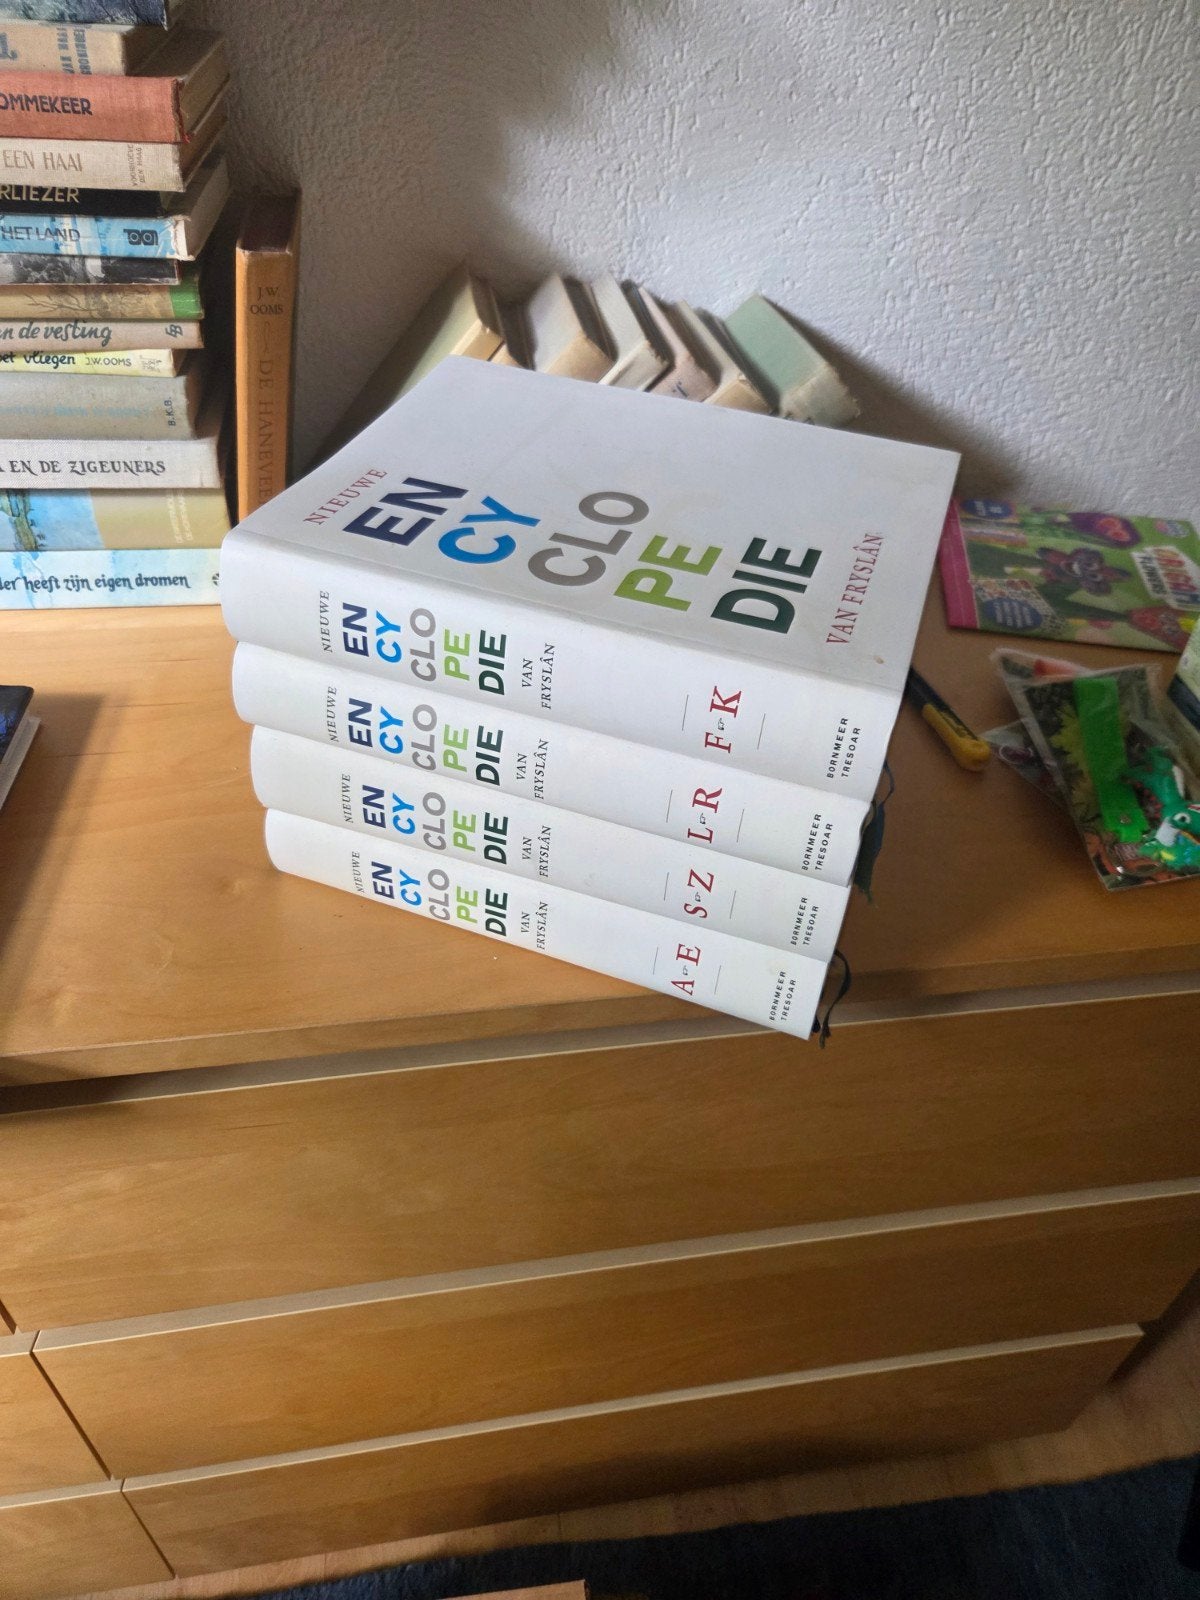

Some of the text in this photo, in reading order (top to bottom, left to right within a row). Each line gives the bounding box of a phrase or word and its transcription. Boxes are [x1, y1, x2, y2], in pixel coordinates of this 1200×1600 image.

[2, 149, 83, 172] EEN HAAI
[35, 227, 81, 242] LAND
[18, 320, 41, 340] de
[43, 319, 113, 347] vesting
[250, 304, 284, 315] OOMS
[22, 350, 76, 369] vliegen
[104, 357, 132, 367] OOMS
[258, 359, 274, 391] DE
[8, 460, 38, 476] EN
[38, 460, 61, 473] DE
[67, 460, 166, 476] ZIGEUNERS
[303, 469, 387, 525] NIEUWE
[342, 477, 469, 546] EN
[438, 496, 541, 564] CY
[528, 491, 650, 587] CLO
[22, 575, 61, 593] heeft
[63, 574, 93, 593] zijn
[94, 574, 134, 592] eigen
[135, 573, 191, 588] dromen
[613, 535, 723, 611] PE
[710, 537, 822, 634] DIE
[826, 533, 885, 645] VAN FRYSLÂN
[319, 591, 333, 653] NIEUWE
[342, 602, 369, 657] EN
[376, 610, 402, 663] CY
[409, 608, 437, 682] CLO
[443, 629, 471, 681] PE
[478, 630, 507, 696] DIE
[521, 658, 533, 689] VAN
[541, 643, 556, 709] FRYSLÂN
[326, 686, 339, 742] NIEUWE
[348, 698, 373, 747] EN
[379, 706, 404, 754] CY
[411, 704, 437, 771] CLO
[704, 686, 742, 753] F K
[443, 724, 469, 772] PE
[475, 725, 504, 786] DIE
[516, 753, 528, 780] VAN
[534, 738, 549, 800] FRYSLÂN
[826, 717, 848, 779] BORNMEER
[841, 727, 861, 777] TRESOAR
[341, 773, 354, 823] NIEUWE
[362, 784, 387, 828] EN
[392, 792, 416, 835] CY
[422, 791, 447, 850] CLO
[687, 788, 723, 844] L R
[452, 810, 477, 852] PE
[484, 812, 509, 864] DIE
[521, 836, 532, 860] VAN
[539, 825, 551, 877] FRYSLÂN
[801, 813, 822, 870] BORNMEER
[815, 823, 833, 871] TRESOAR
[351, 851, 365, 893] NIEUWE
[371, 861, 395, 899] EN
[399, 868, 423, 907] CY
[427, 868, 450, 921] CLO
[683, 868, 715, 919] S Z
[456, 885, 479, 924] PE
[485, 888, 508, 937] DIE
[520, 911, 531, 933] VAN
[536, 901, 548, 950] FRYSLÂN
[790, 897, 808, 946] BORNMEER
[803, 905, 819, 946] TRESOAR
[670, 943, 701, 996] A E
[769, 970, 786, 1021] BORNMEER
[780, 979, 796, 1021] TRESOAR
